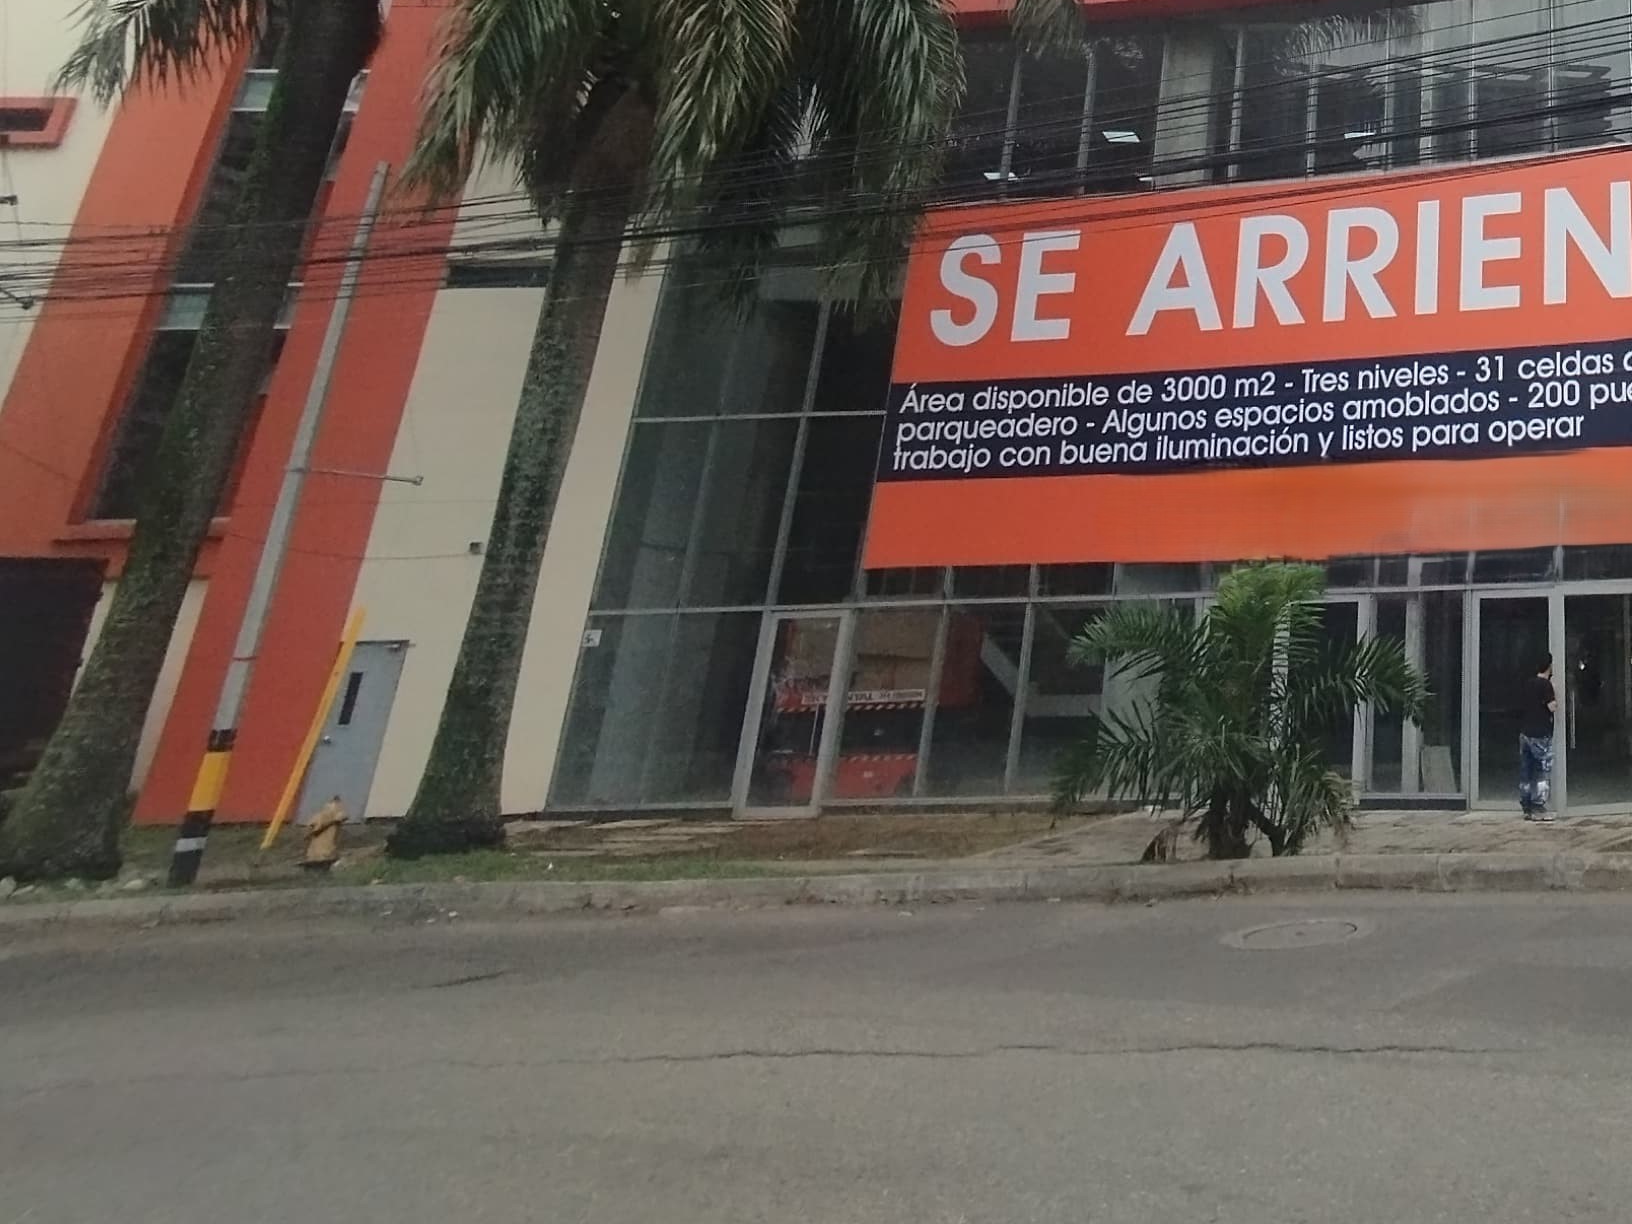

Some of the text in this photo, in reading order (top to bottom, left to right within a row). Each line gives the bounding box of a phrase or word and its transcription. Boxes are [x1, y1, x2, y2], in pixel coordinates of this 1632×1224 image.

[929, 230, 1082, 347] SE
[897, 413, 1078, 445] parqueadero
[1101, 409, 1207, 438] Algunos
[1214, 398, 1334, 431] espacios
[1343, 388, 1500, 420] amoblados
[1527, 378, 1580, 410] 200
[899, 383, 964, 413] Área
[972, 383, 1109, 413] disponible
[1117, 379, 1153, 405] de
[1160, 374, 1228, 403] 3000
[1234, 370, 1276, 398] m2
[1301, 368, 1350, 395] Tres
[1357, 361, 1449, 389] niveles
[1474, 355, 1505, 384] 31
[1517, 350, 1613, 378] celdas
[893, 413, 1584, 473] trabajo con buena iluminación y listos para operar
